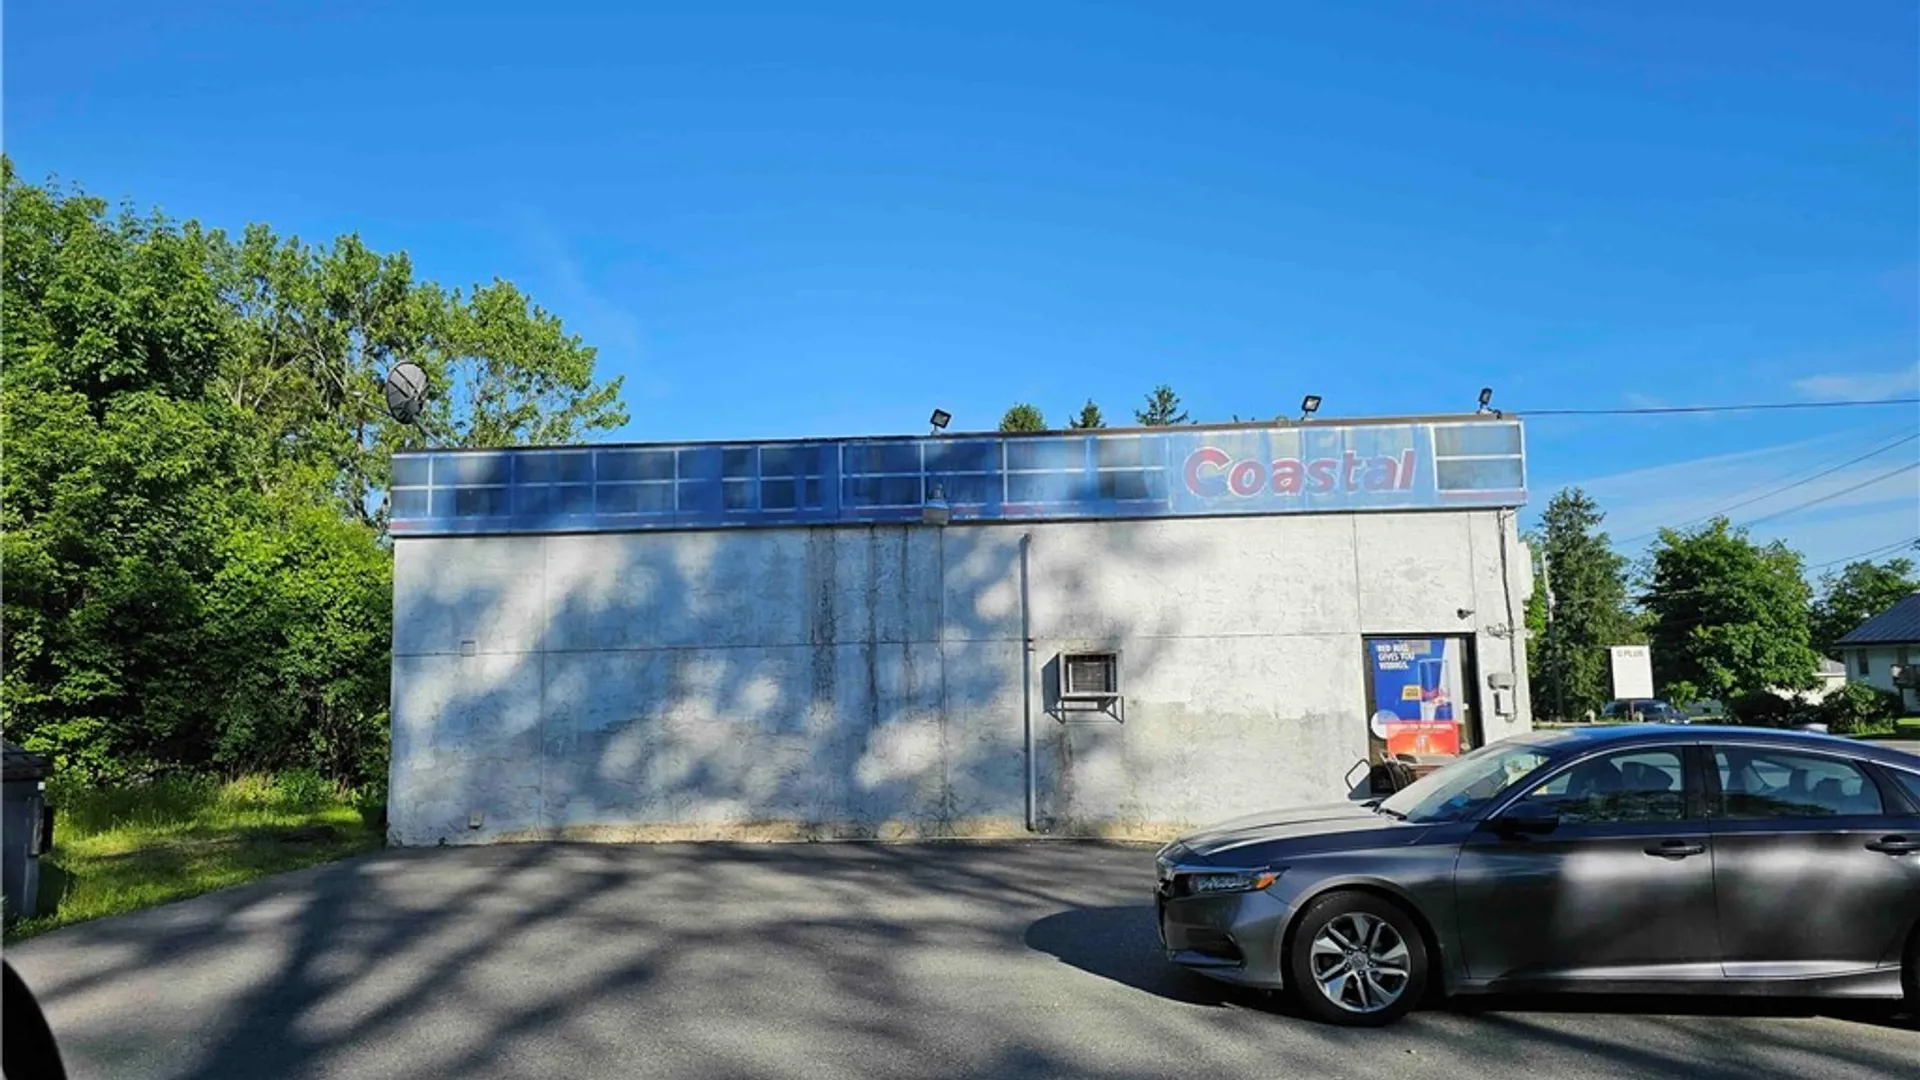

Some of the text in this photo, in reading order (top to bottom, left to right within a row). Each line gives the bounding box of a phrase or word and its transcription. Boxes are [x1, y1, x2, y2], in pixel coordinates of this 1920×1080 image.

[1183, 445, 1416, 498] Coastal
[1378, 652, 1415, 661] GIVES YOU
